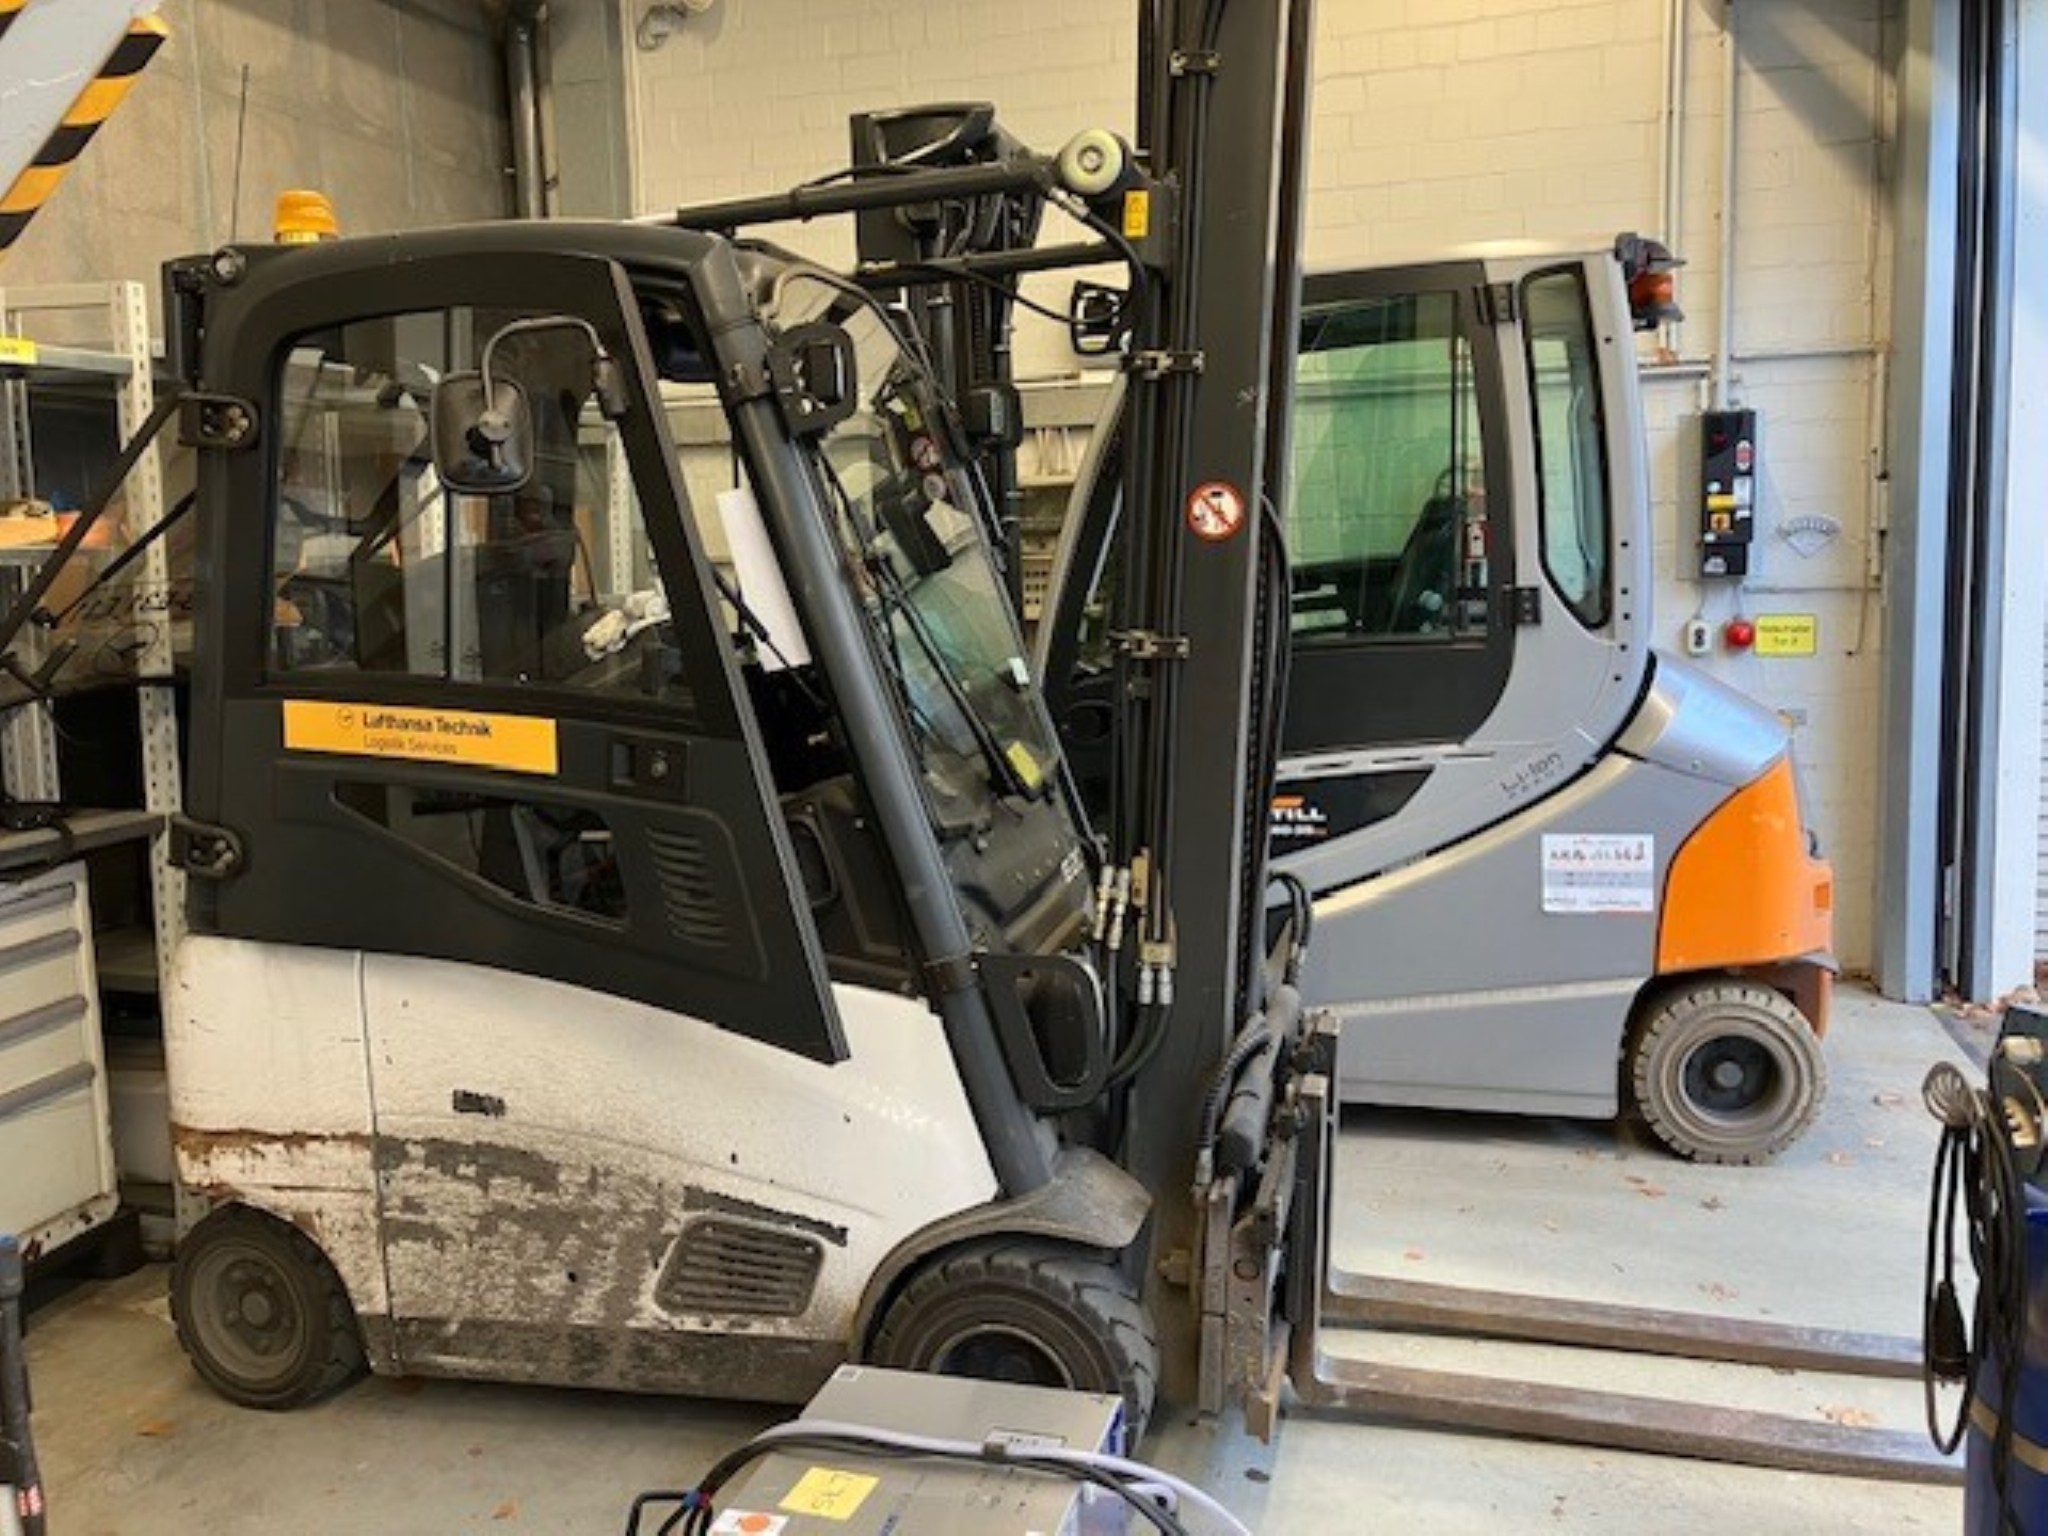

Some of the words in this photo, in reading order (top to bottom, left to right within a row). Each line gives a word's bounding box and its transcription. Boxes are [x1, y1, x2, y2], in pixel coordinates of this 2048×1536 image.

[363, 712, 431, 733] Lufthansa
[434, 714, 491, 737] Technik
[363, 734, 405, 751] Logistik
[408, 737, 458, 754] Services
[1269, 807, 1328, 822] TILL
